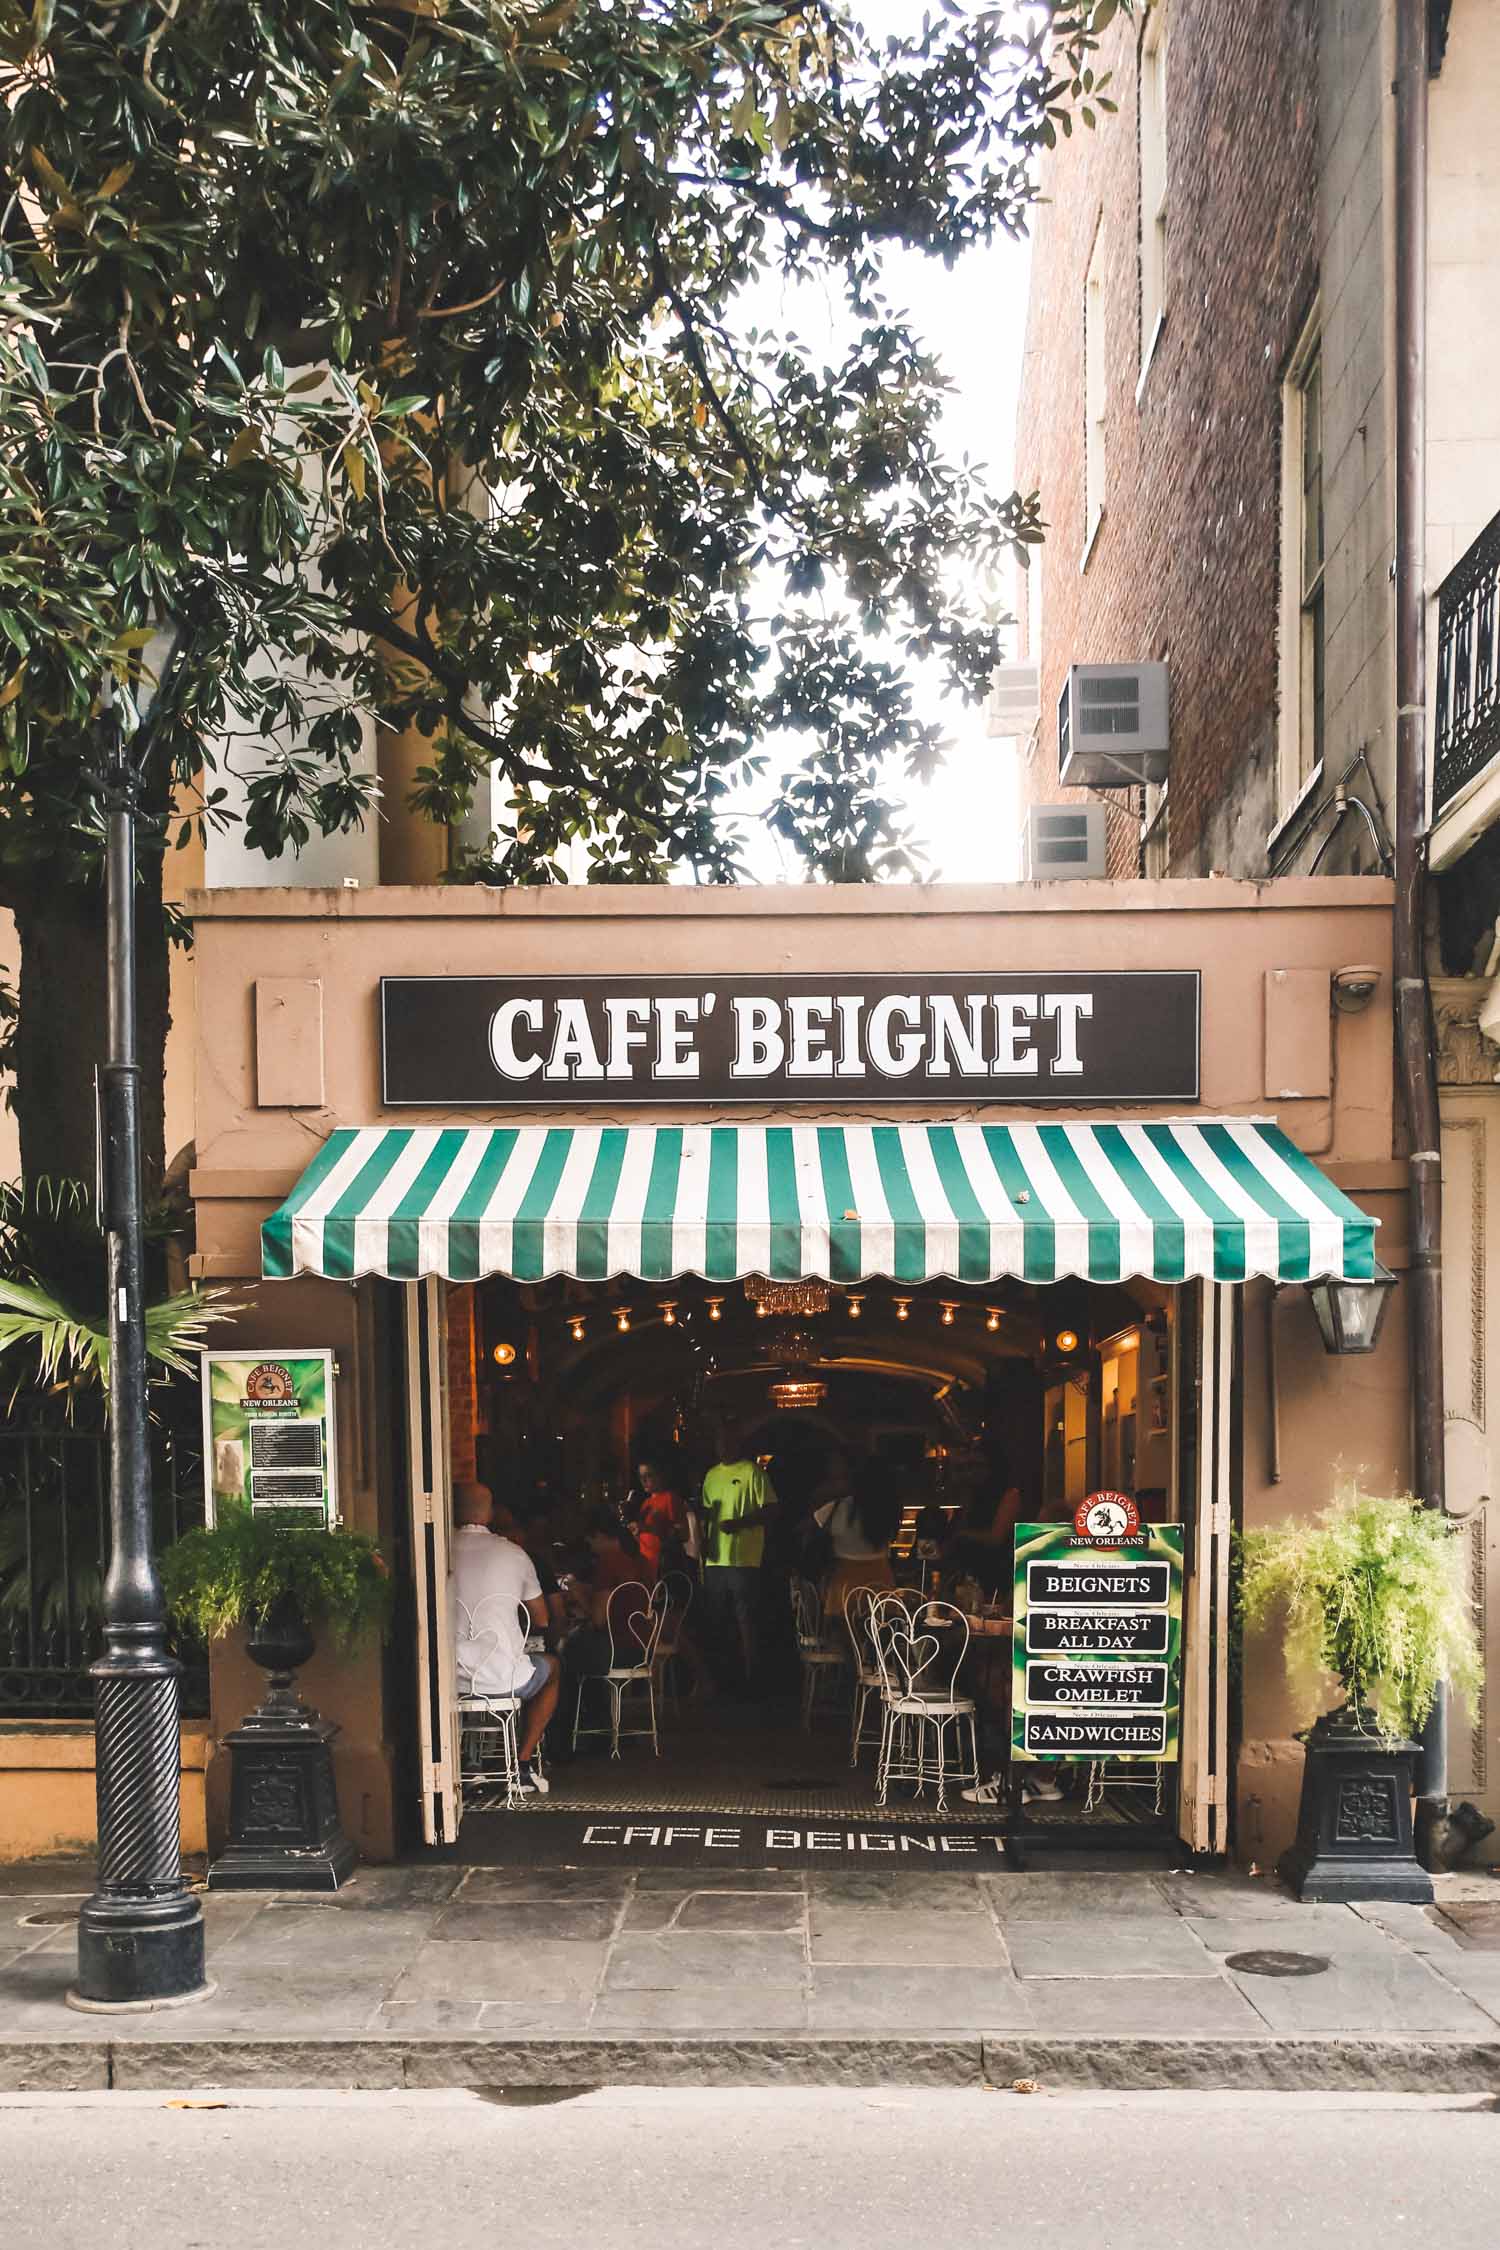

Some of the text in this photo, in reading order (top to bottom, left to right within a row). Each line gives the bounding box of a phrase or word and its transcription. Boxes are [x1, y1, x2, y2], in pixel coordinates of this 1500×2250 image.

[729, 992, 1093, 1081] BEIGNET
[247, 1364, 293, 1393] CAFE BEIGNET
[1077, 1492, 1137, 1527] CAFE BEIGNET
[1070, 1537, 1144, 1546] NEW ORLEANS
[1046, 1576, 1150, 1593] BEIGNETS
[1045, 1617, 1151, 1631] BREAKFAST
[1058, 1635, 1136, 1648] ALL DAY
[1044, 1668, 1153, 1683] CRAWFISH
[1055, 1688, 1142, 1702] OMELET
[1030, 1725, 1161, 1741] SANDWICHES
[582, 1825, 1008, 1852] CAFE BEIGNET
